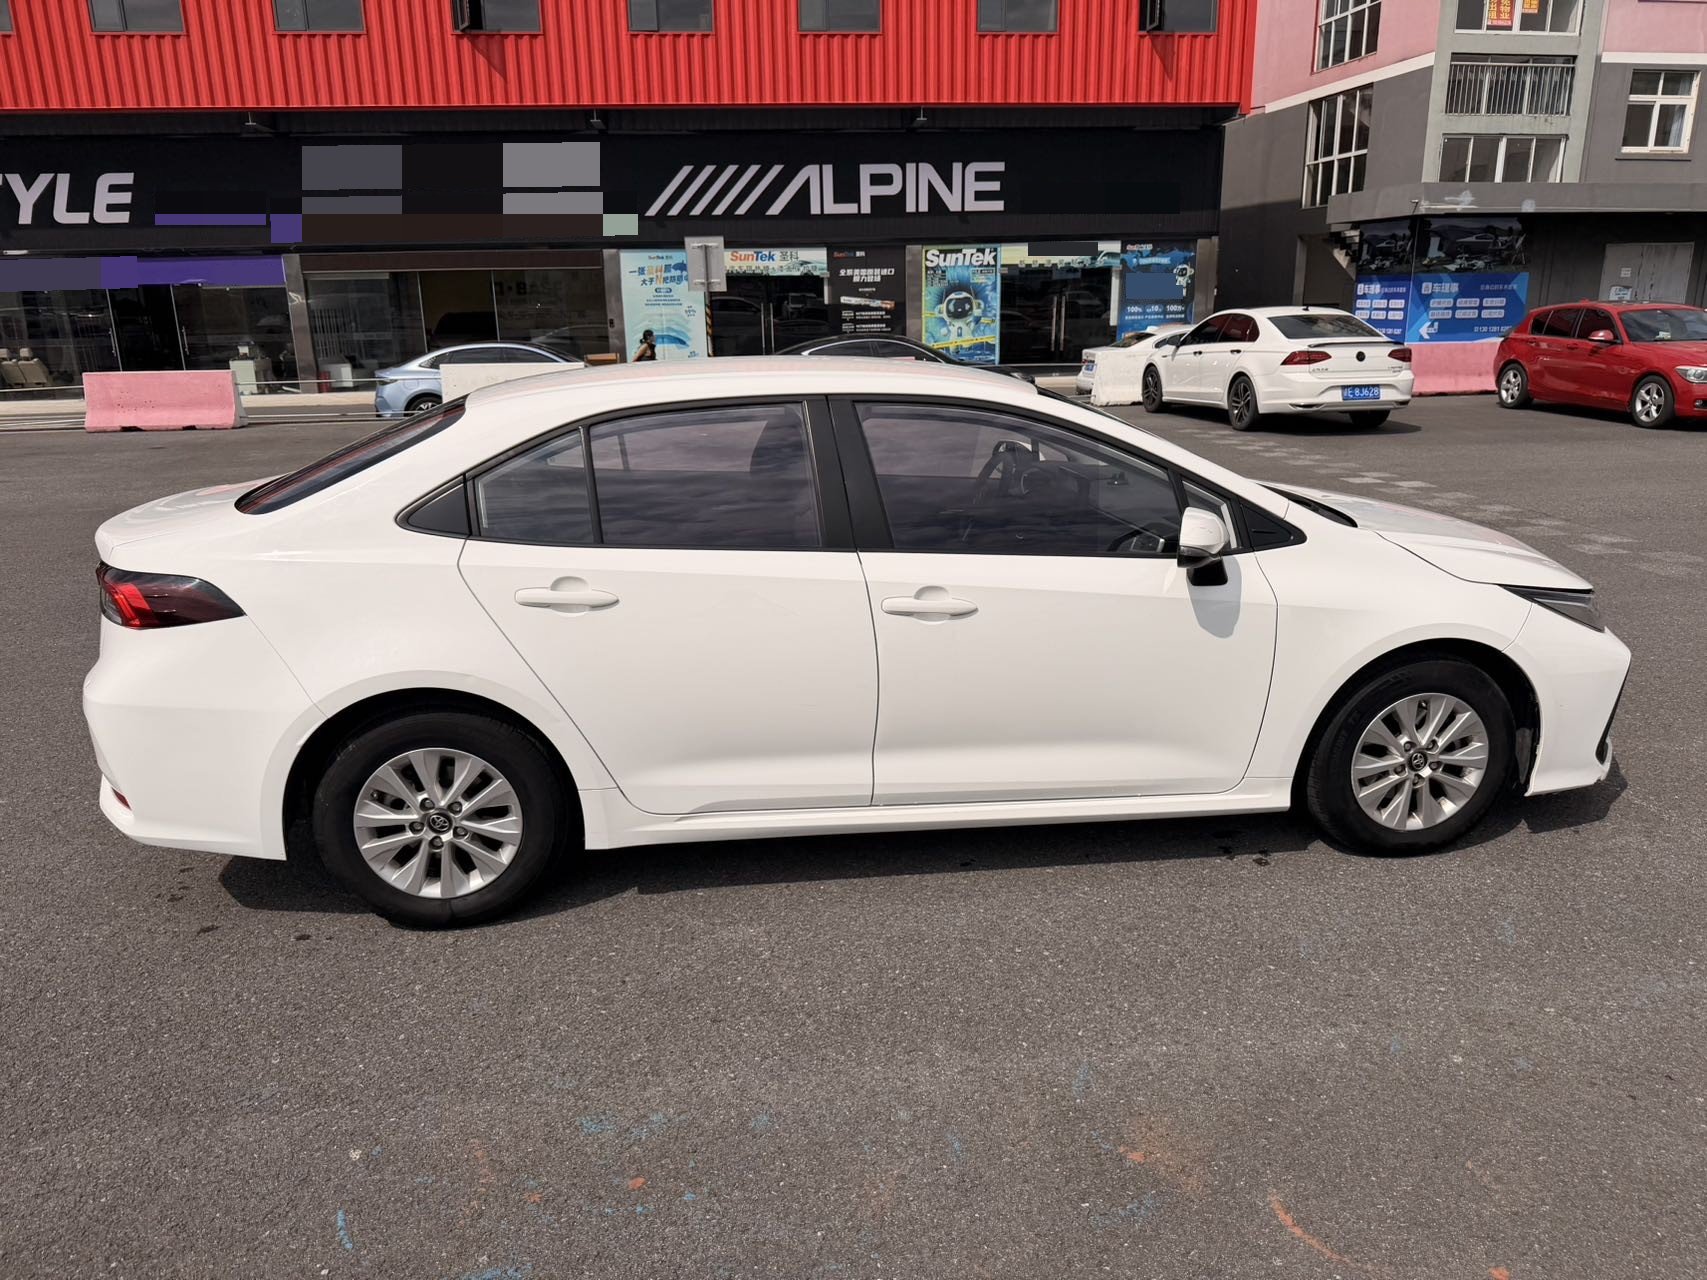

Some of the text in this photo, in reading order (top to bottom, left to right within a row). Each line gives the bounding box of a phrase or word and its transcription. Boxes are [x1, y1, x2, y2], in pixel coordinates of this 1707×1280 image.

[0, 172, 135, 225] YLE
[764, 161, 1006, 216] ALPINE
[730, 250, 775, 262] SunTek
[925, 248, 997, 268] SunTek
